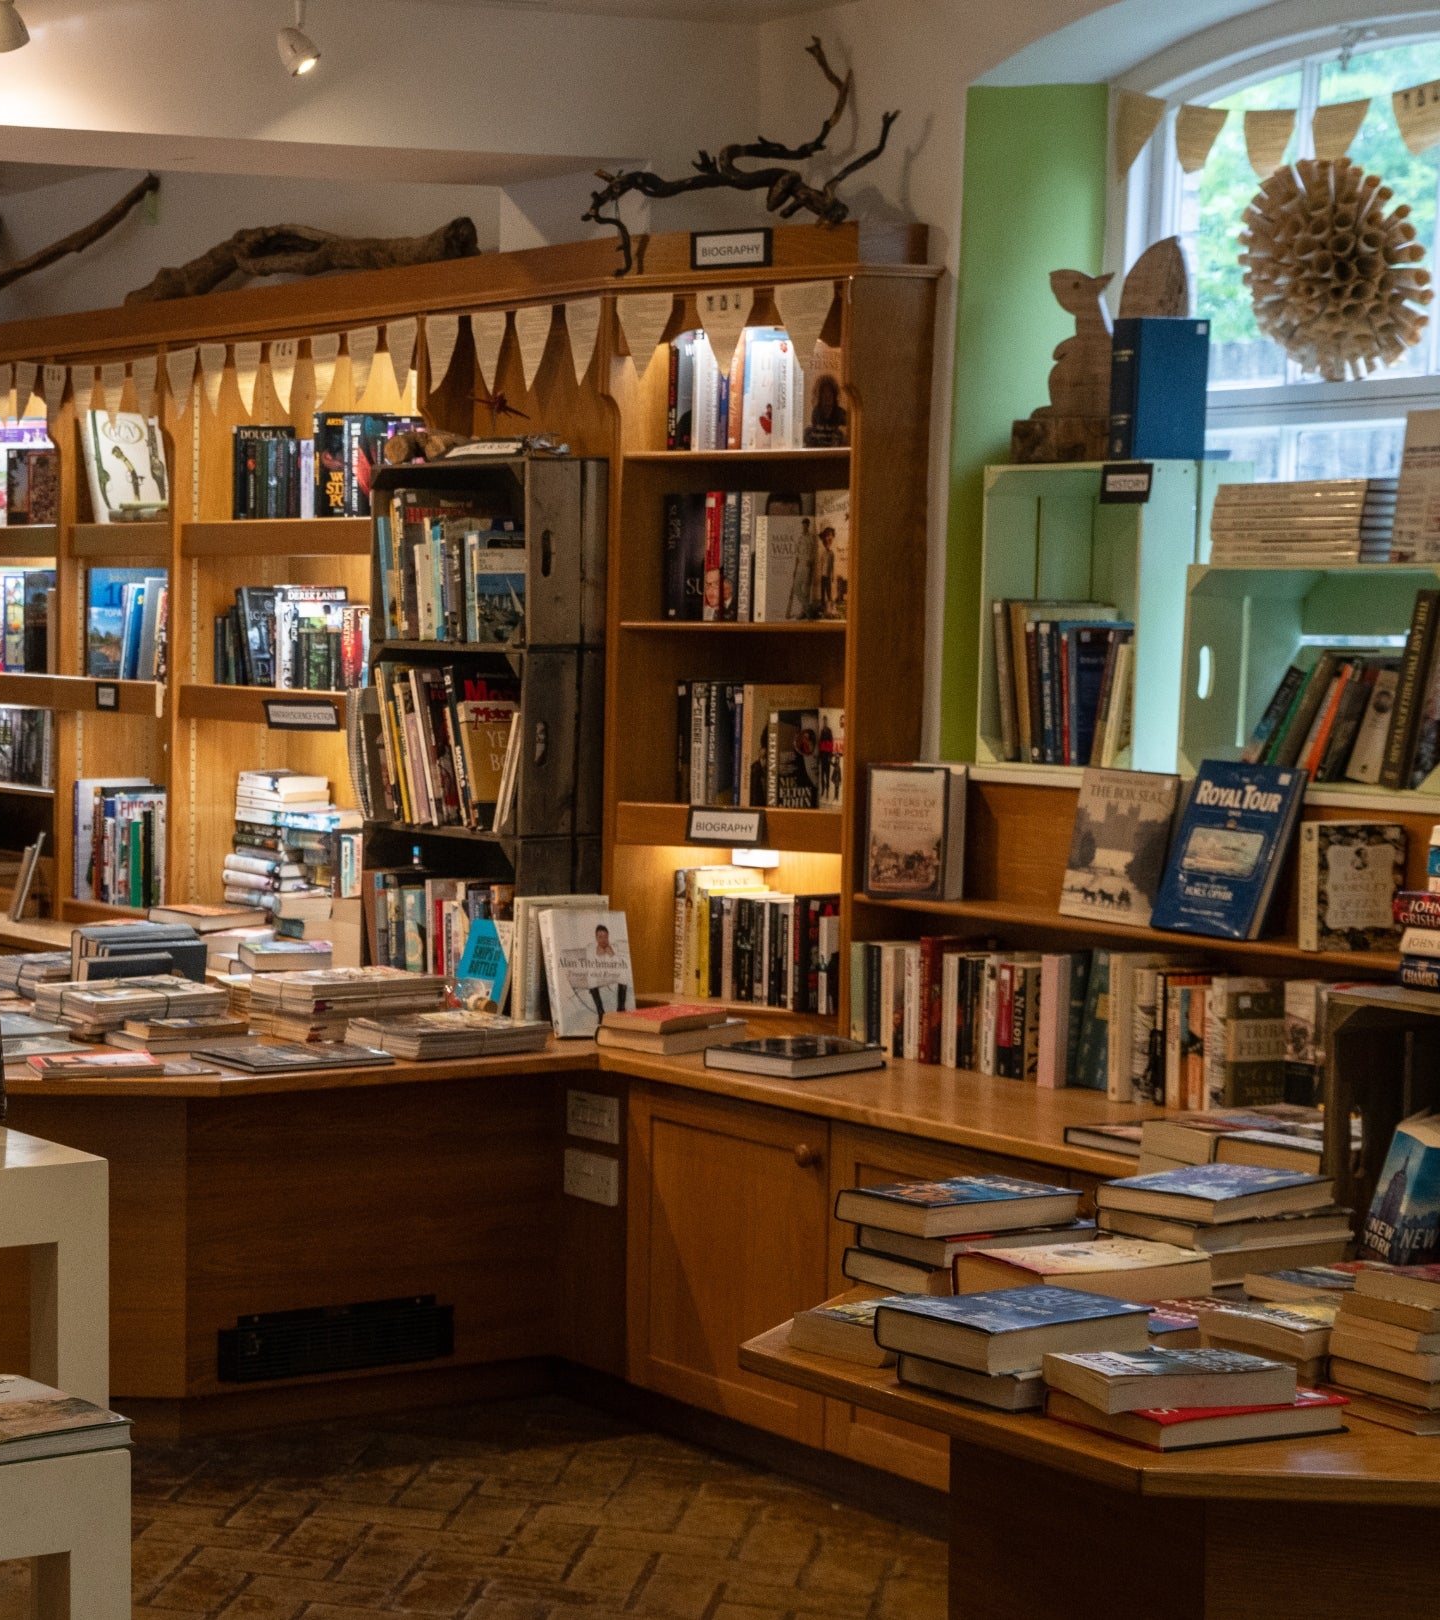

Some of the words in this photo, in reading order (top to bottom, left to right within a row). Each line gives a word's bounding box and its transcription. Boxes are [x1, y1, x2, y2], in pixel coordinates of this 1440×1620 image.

[701, 244, 760, 257] BIOGRAPHY
[240, 429, 288, 440] DOUGLAS
[1109, 478, 1147, 490] HISTORY
[741, 495, 751, 535] KEVIN
[738, 544, 751, 614] PIETERSEN
[288, 591, 316, 600] DEREK
[316, 591, 345, 600] LAND
[1090, 784, 1110, 797] THE
[1195, 780, 1243, 809] ROYAL
[1243, 784, 1283, 813] TOUR
[695, 821, 754, 833] BIOGRAPHY
[1400, 913, 1440, 927] GRISHA
[1409, 938, 1435, 948] JOHN
[559, 958, 577, 968] Alan
[579, 957, 628, 969] Titchmarsh
[674, 934, 684, 980] BARLOW
[1402, 969, 1439, 987] CHAMBER
[1013, 996, 1026, 1046] Nelson
[1369, 1217, 1395, 1241] NEW
[1364, 1230, 1392, 1257] YORK
[1400, 1228, 1436, 1249] NEW
